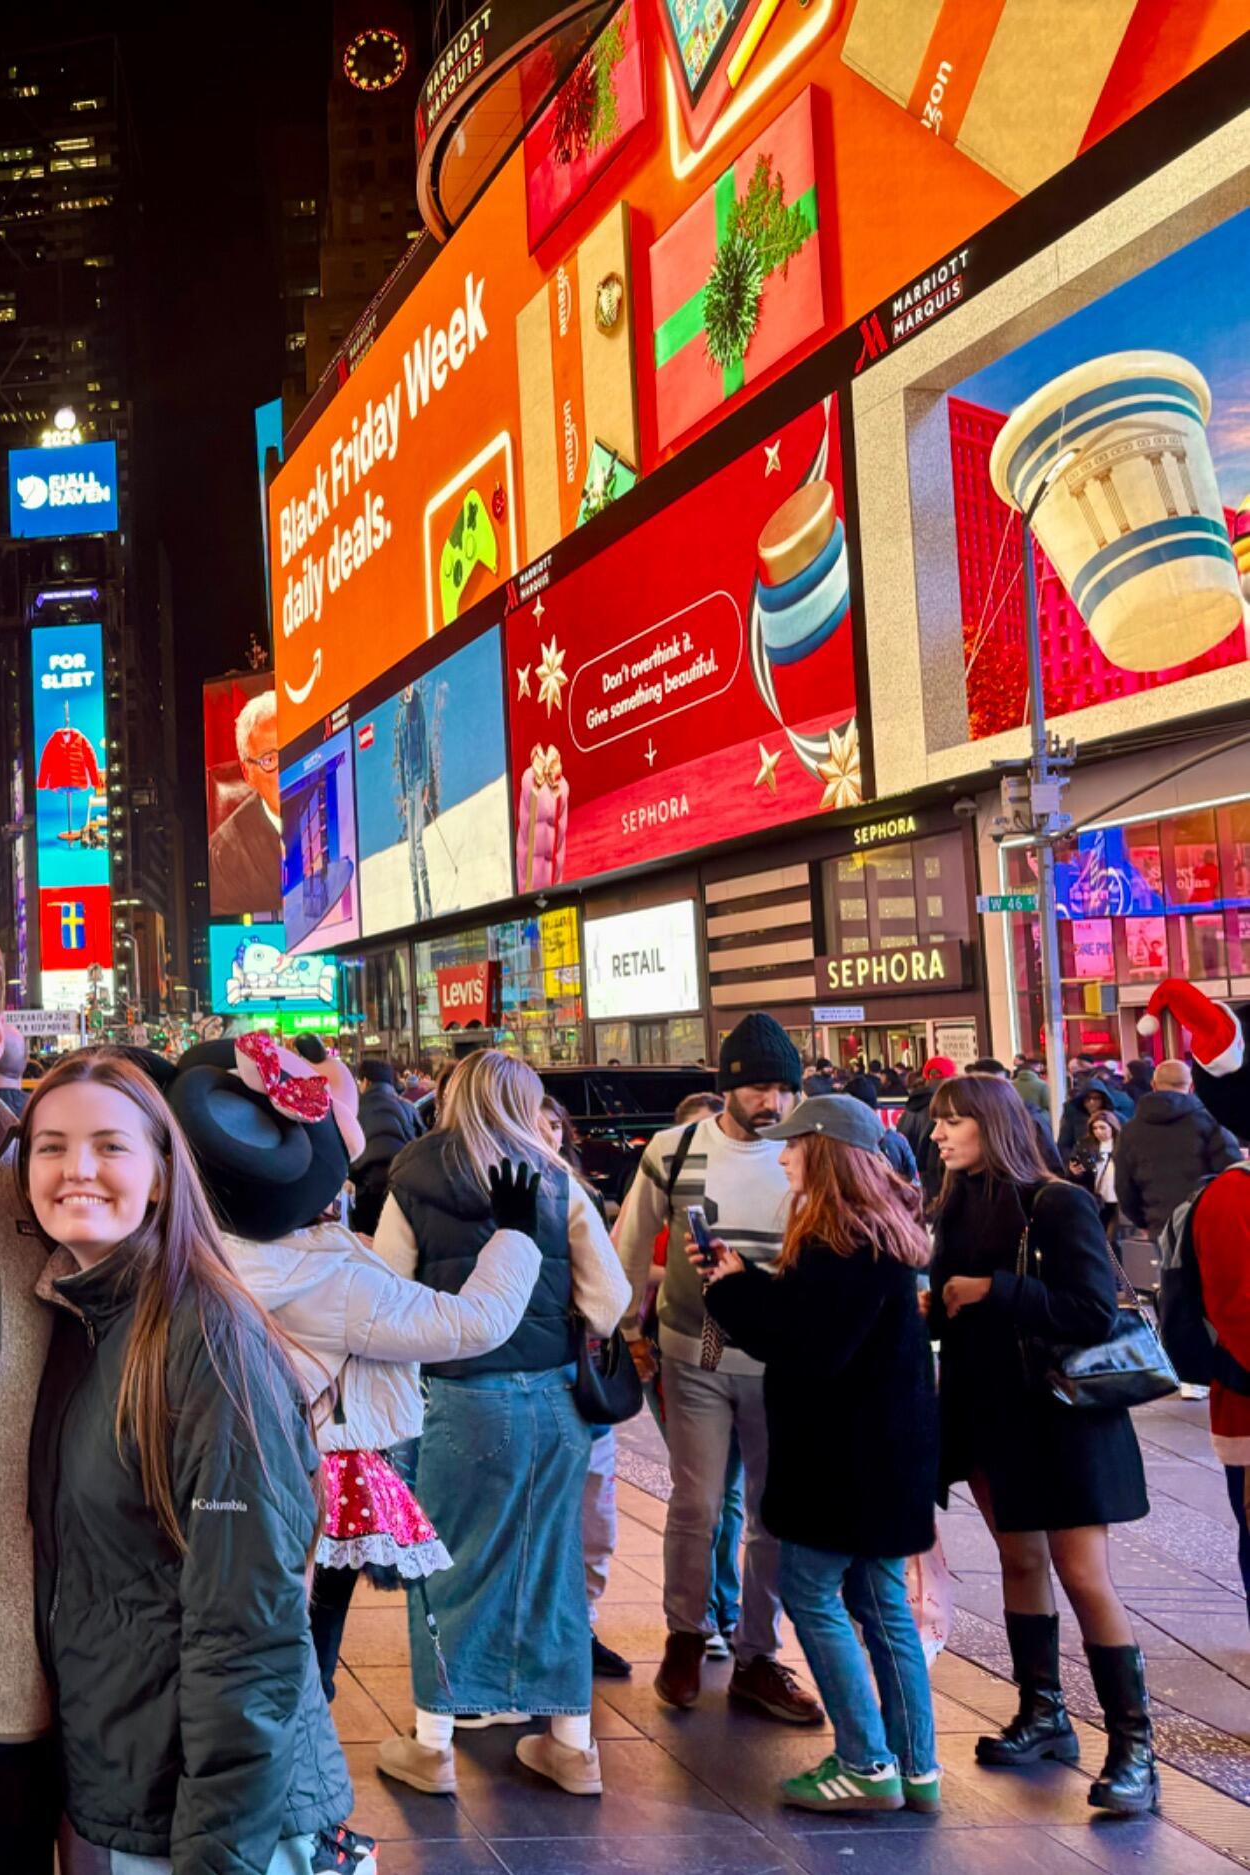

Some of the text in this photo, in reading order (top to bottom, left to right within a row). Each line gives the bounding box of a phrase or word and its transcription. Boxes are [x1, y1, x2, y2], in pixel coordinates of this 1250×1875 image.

[427, 8, 491, 101] MARRIOTT
[428, 46, 483, 127] MARQUIS
[920, 61, 953, 129] zon
[892, 249, 969, 318] MARRIOTT
[893, 280, 961, 339] MARQUIS
[41, 429, 82, 447] 2024
[280, 272, 489, 569] Black Friday Week
[563, 400, 576, 484] amazon
[283, 490, 391, 638] daily deals.
[41, 671, 95, 689] SLEET
[49, 654, 86, 670] FOR
[586, 648, 719, 730] Give something beautiful.
[602, 663, 630, 694] Don't
[631, 634, 681, 679] overthink
[621, 794, 690, 834] SEPHORA
[854, 816, 917, 845] SEPHORA
[990, 898, 1002, 910] W
[1008, 897, 1023, 910] 46
[612, 948, 665, 977] RETAIL
[827, 949, 945, 989] SEPHORA
[197, 1498, 248, 1512] Columbia
